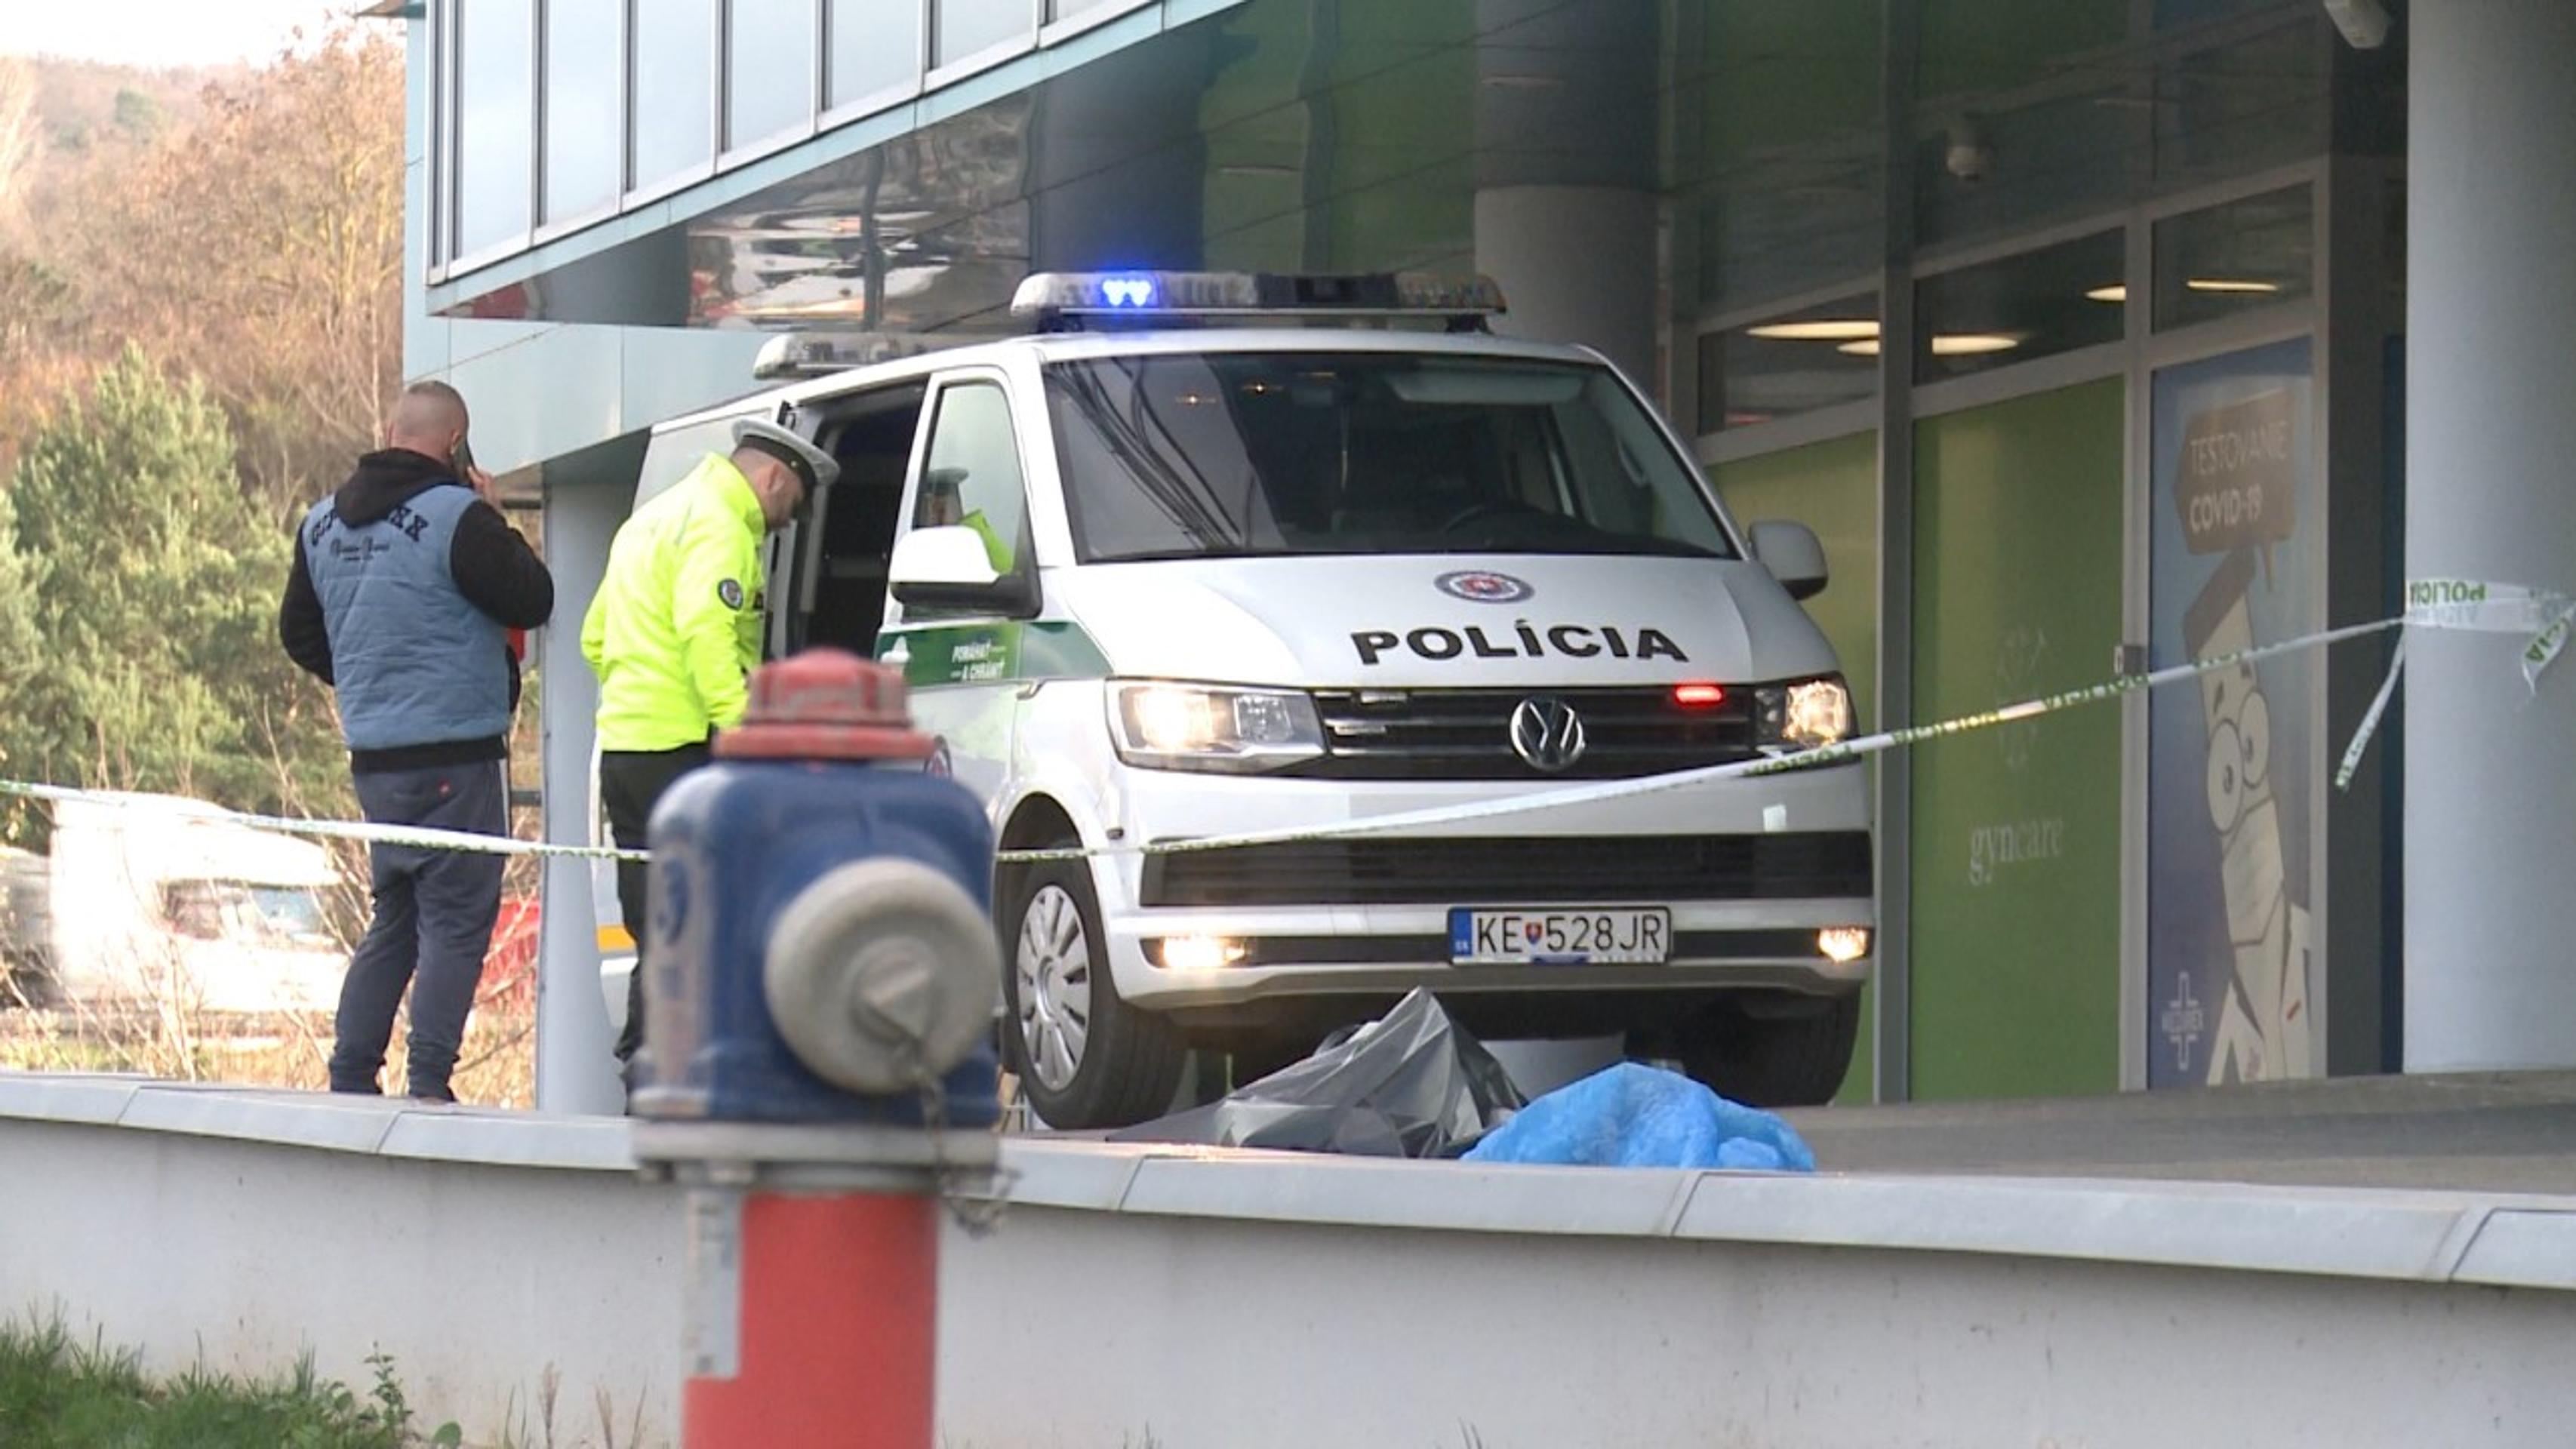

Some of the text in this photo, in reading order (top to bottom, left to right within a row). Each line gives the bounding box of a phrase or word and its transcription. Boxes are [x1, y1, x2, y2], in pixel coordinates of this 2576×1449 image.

[2190, 420, 2288, 476] TESTOVANIE
[2190, 484, 2263, 533] COVID-19
[1350, 619, 1690, 666] POLÍCIA
[1969, 818, 2064, 887] gyncare
